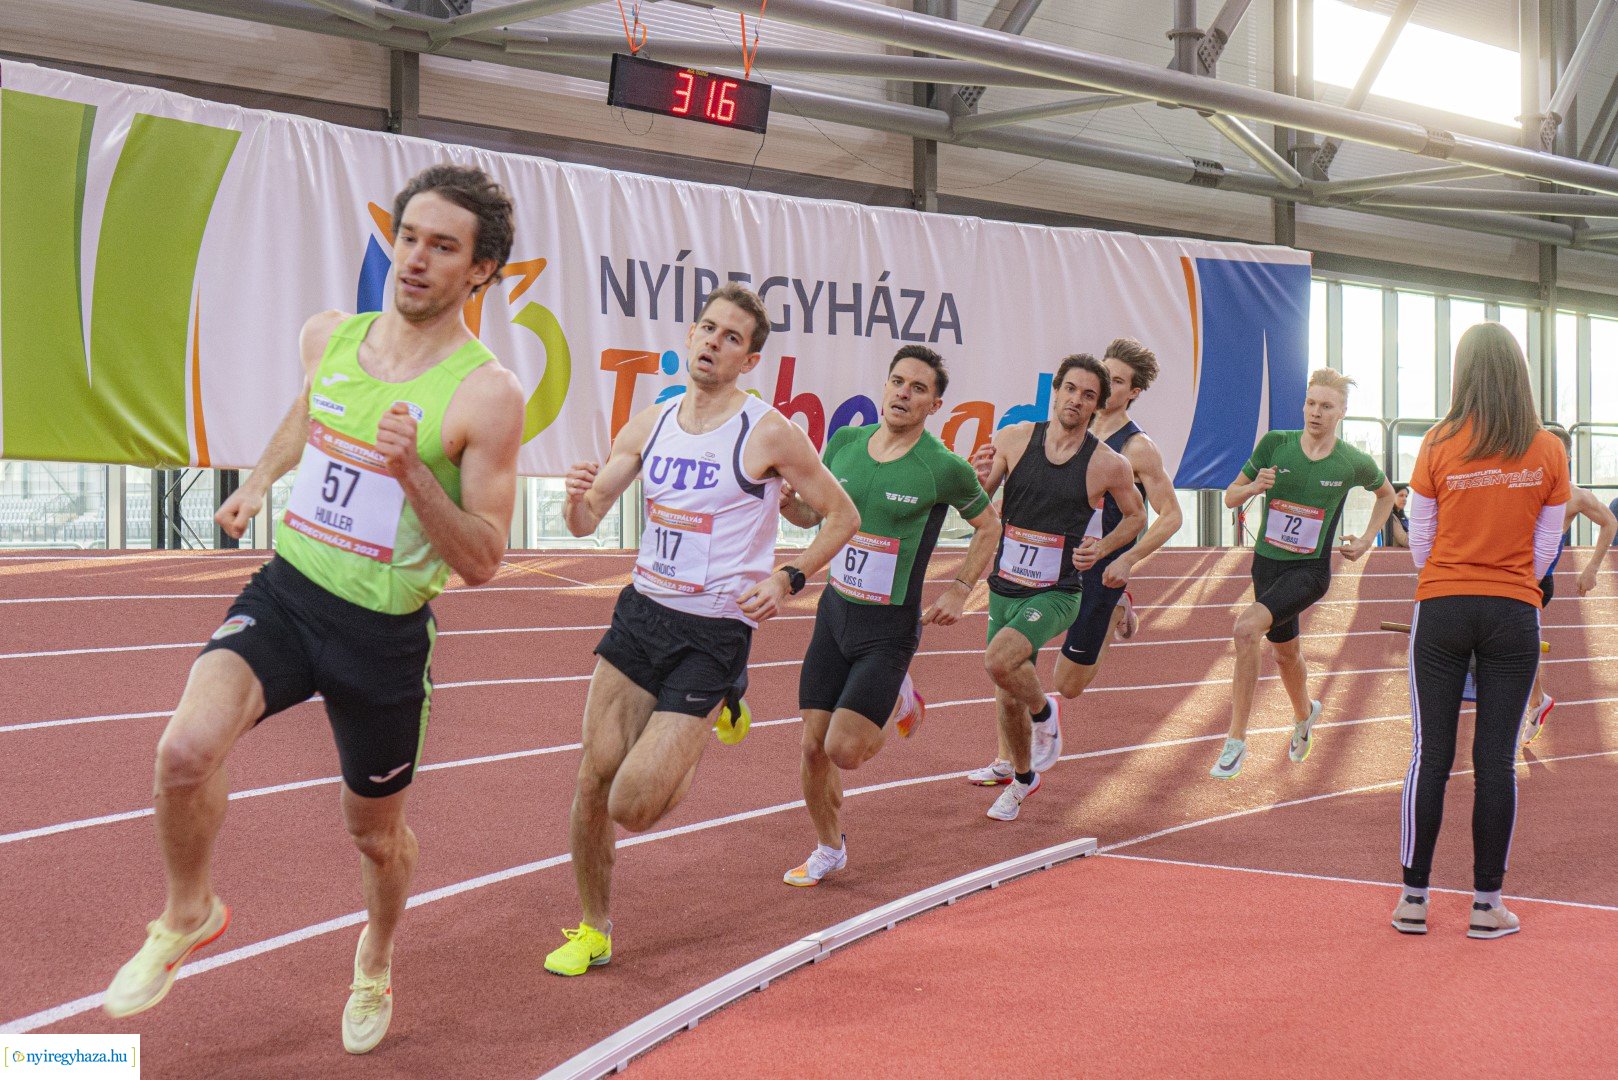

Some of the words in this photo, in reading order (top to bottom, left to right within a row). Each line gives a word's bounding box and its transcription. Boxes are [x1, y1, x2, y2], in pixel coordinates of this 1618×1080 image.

[600, 249, 963, 345] NYÍRGYHÁZA
[321, 461, 361, 508] 57
[649, 456, 721, 490] UTE
[1446, 467, 1543, 491] VERSENYBÍRÓ
[315, 507, 353, 532] HULLER
[1284, 514, 1302, 536] 72
[655, 526, 682, 561] 117
[1019, 543, 1039, 567] 77
[845, 547, 869, 574] 67
[843, 574, 857, 586] KISS
